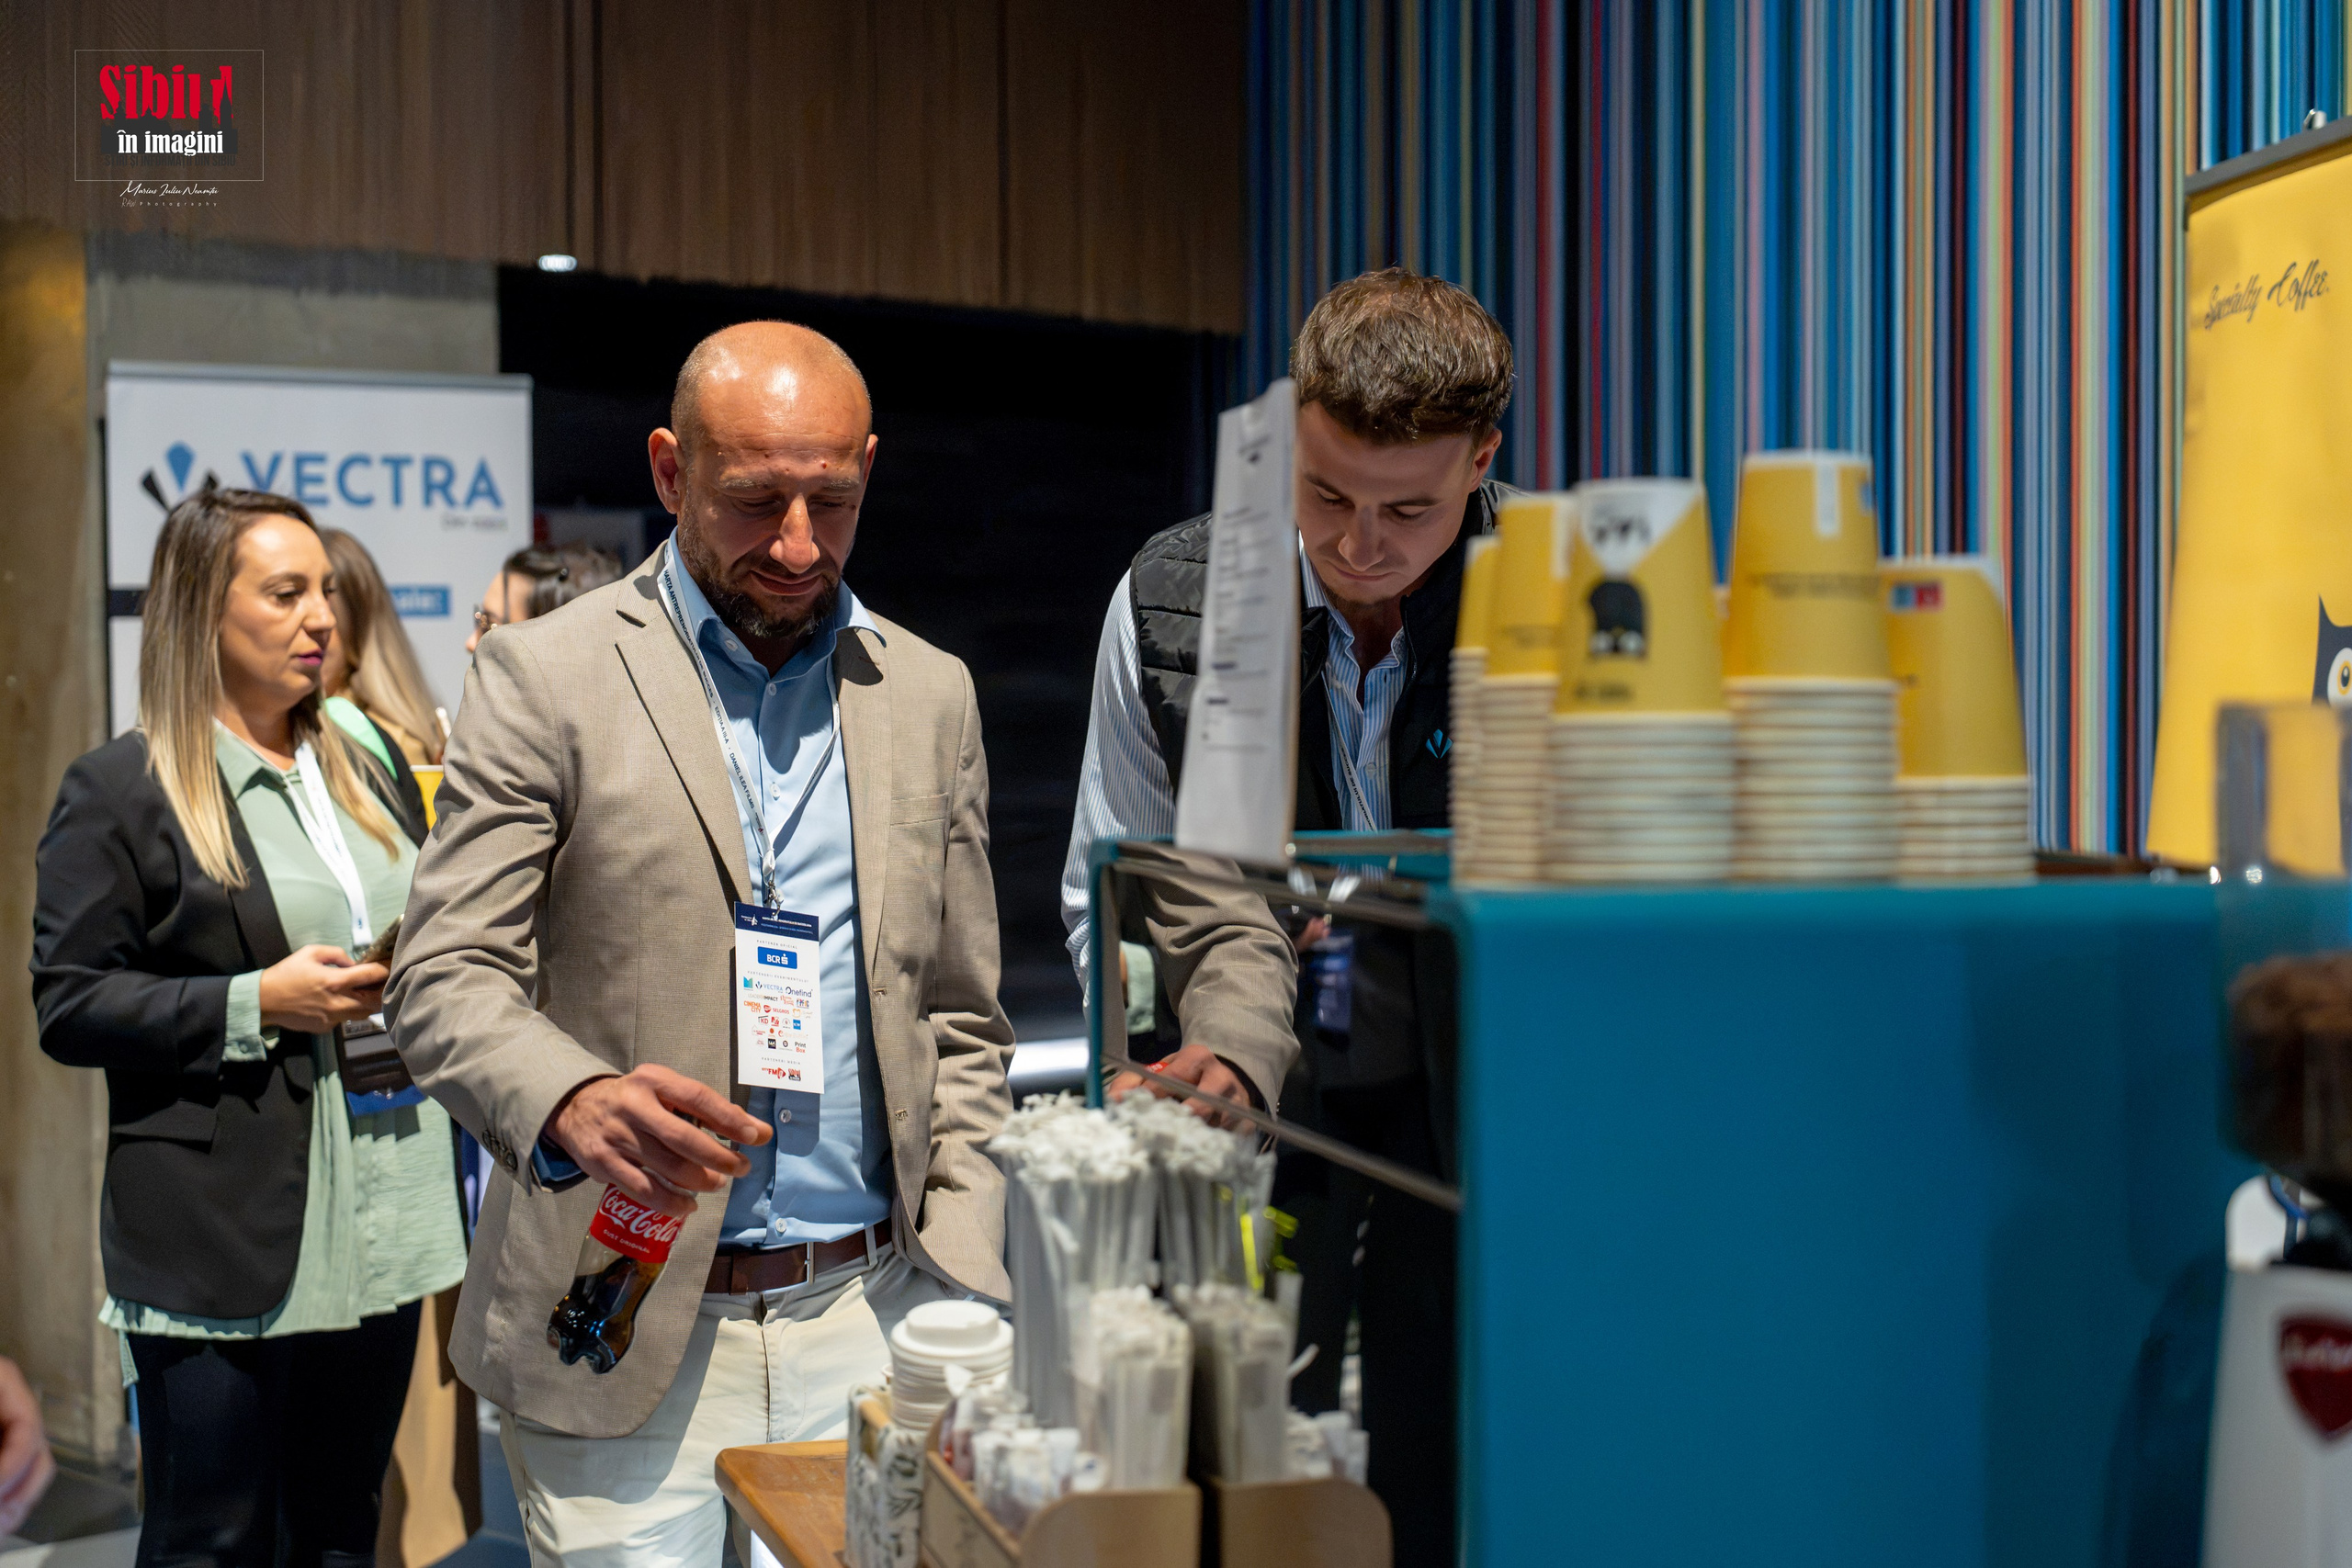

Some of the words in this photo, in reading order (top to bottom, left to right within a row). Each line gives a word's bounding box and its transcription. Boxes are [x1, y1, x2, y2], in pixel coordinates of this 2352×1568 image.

[241, 451, 504, 510] VECTRA
[663, 570, 673, 592] HARTA
[729, 752, 741, 776] DANIEL
[744, 789, 754, 809] FILMS
[766, 954, 780, 964] BCR
[763, 983, 783, 991] VECTRA
[786, 986, 812, 998] Onefind
